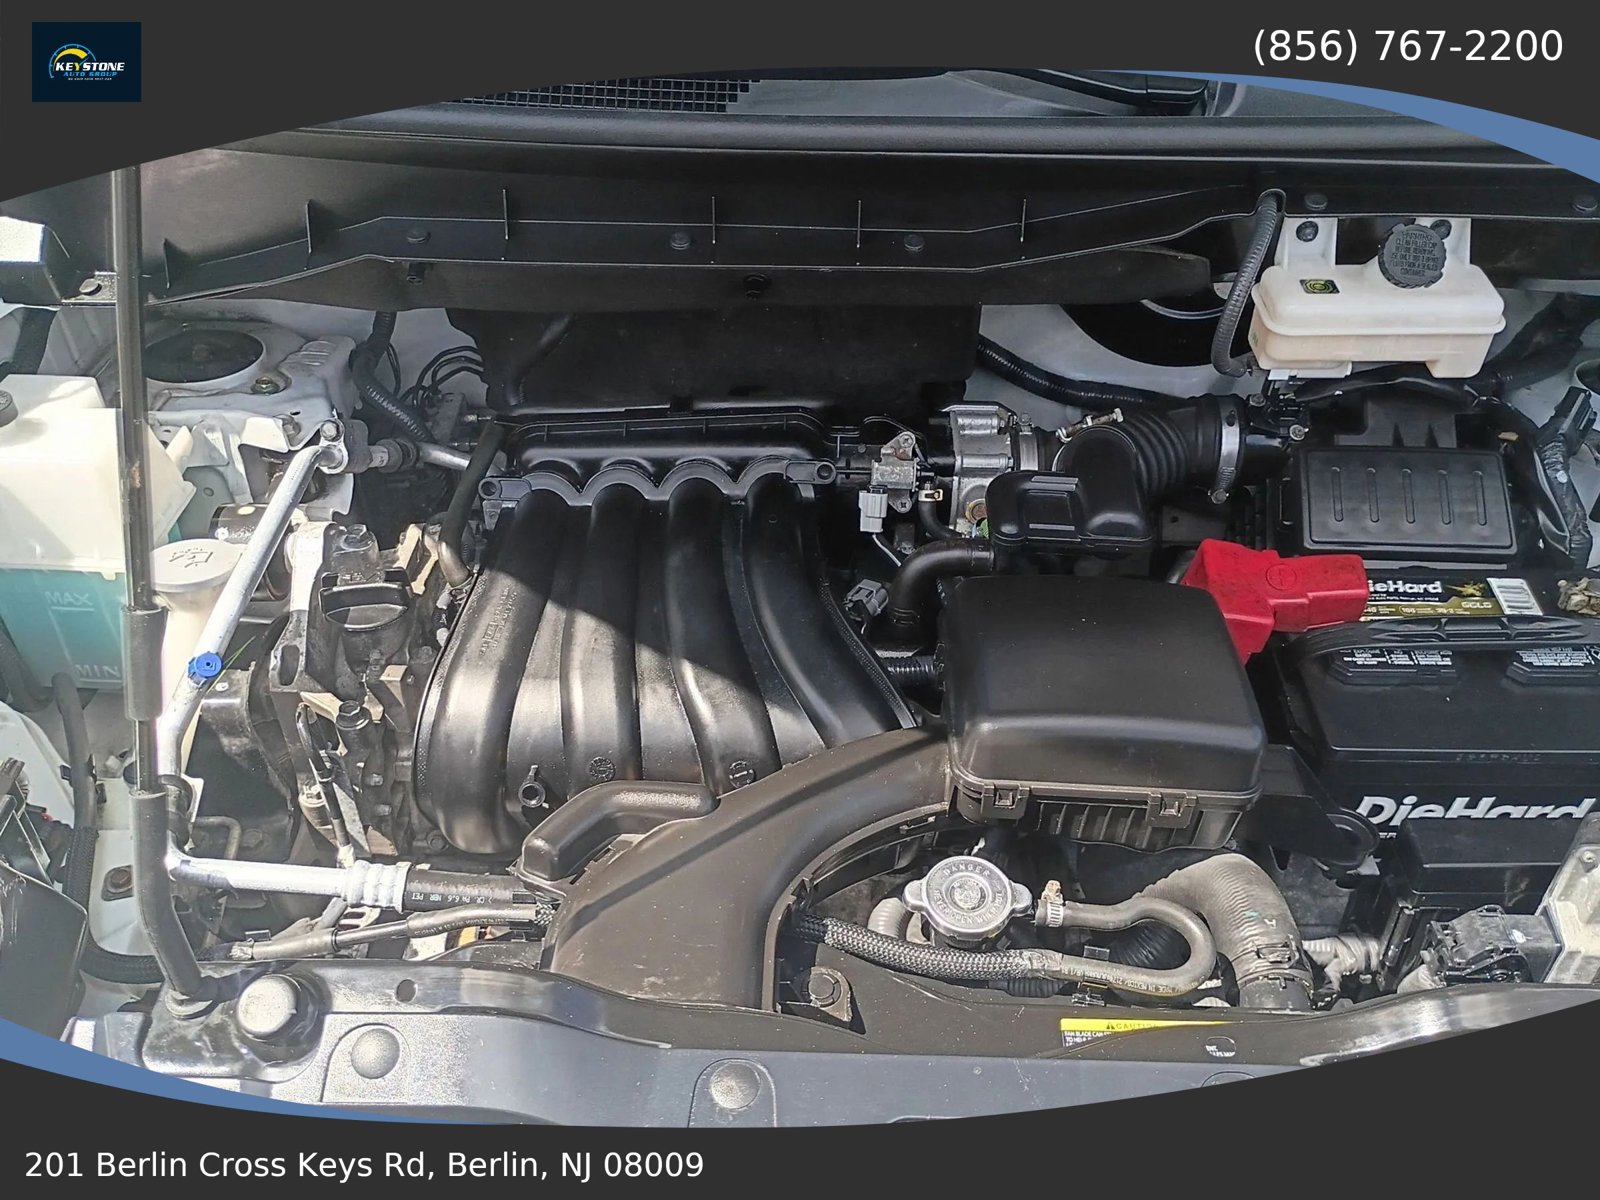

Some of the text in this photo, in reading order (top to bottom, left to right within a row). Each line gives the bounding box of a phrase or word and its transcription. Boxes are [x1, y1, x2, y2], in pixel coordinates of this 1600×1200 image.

[1367, 580, 1443, 594] ieHard
[45, 592, 93, 606] MAX
[75, 664, 120, 678] MIN
[1356, 796, 1596, 827] DieHard
[943, 863, 991, 877] DANGER
[411, 892, 424, 901] PET
[951, 912, 974, 924] OPEN
